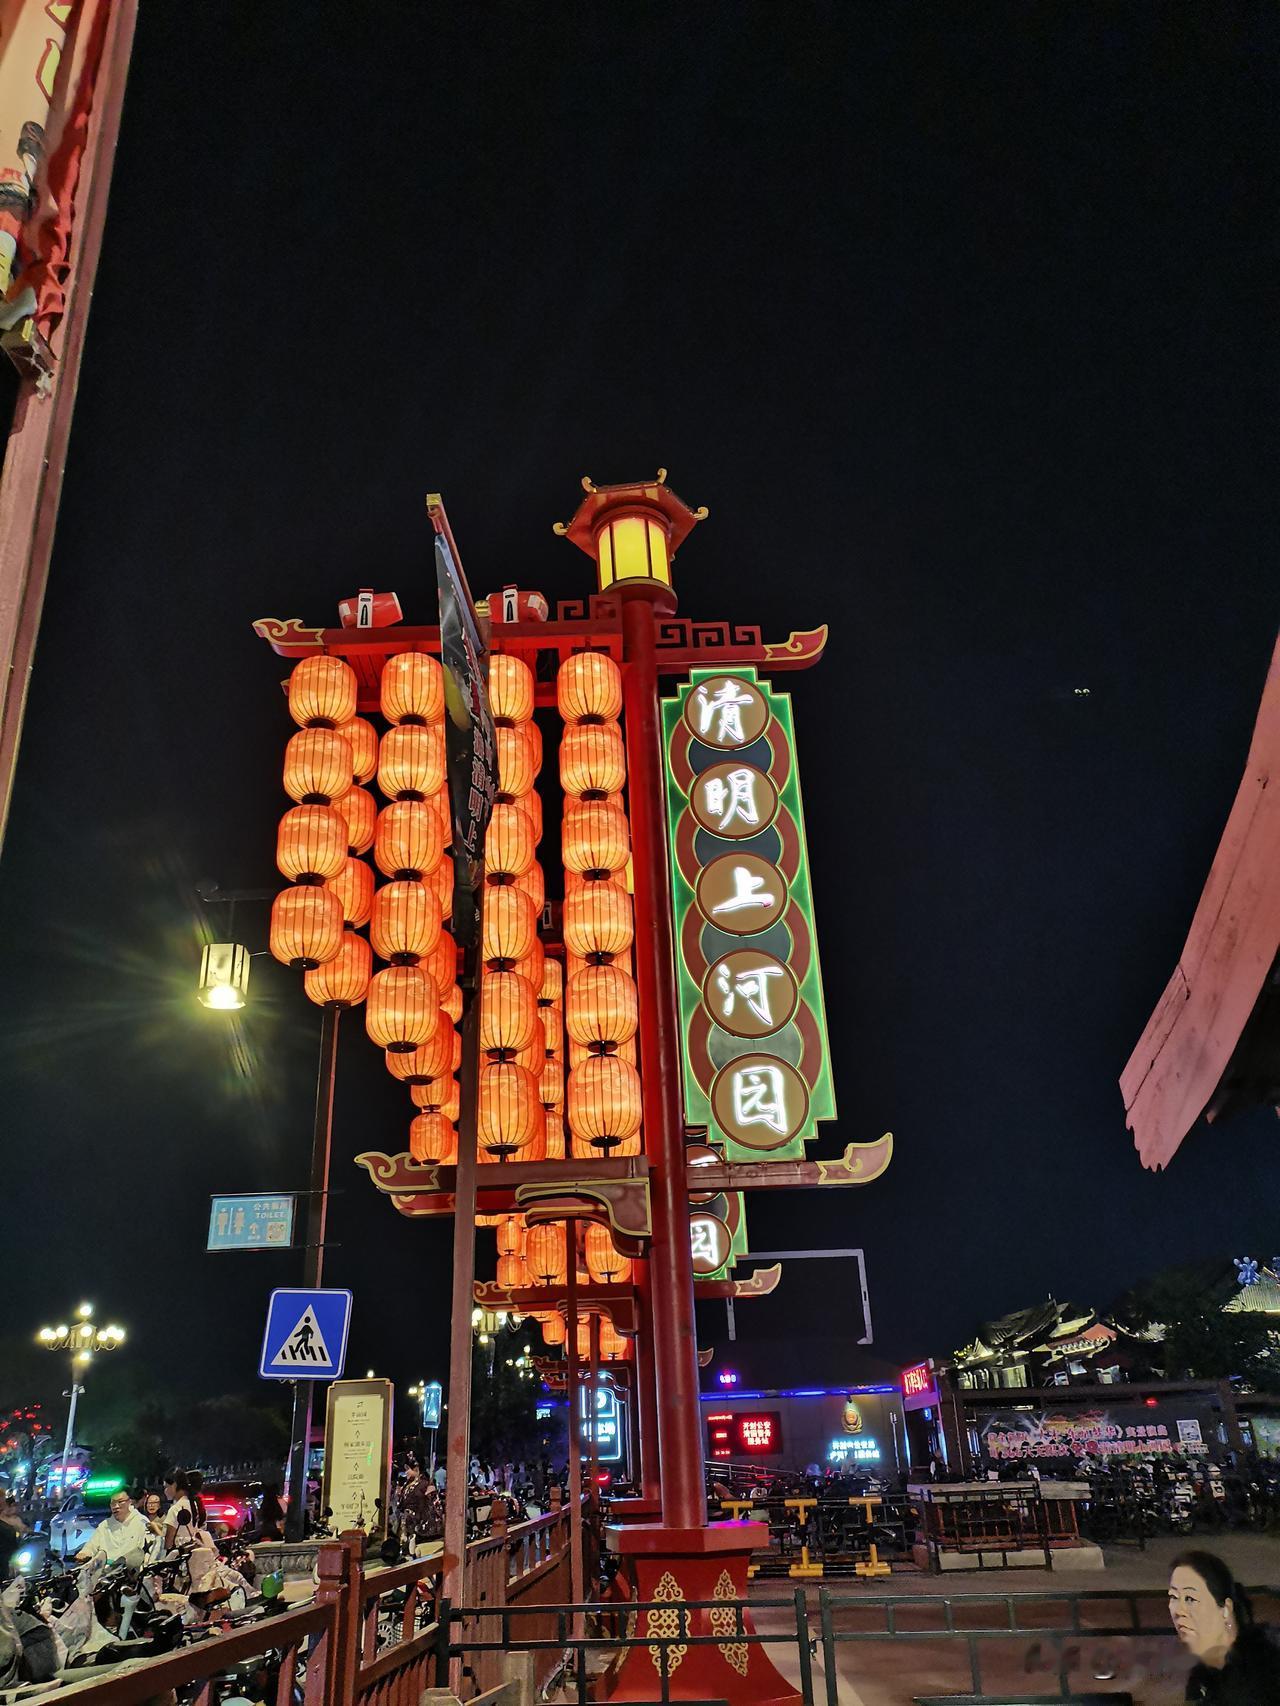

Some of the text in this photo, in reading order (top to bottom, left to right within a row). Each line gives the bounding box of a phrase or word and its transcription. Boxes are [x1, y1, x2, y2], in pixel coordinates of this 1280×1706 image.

[697, 680, 788, 1134] 清明上河园
